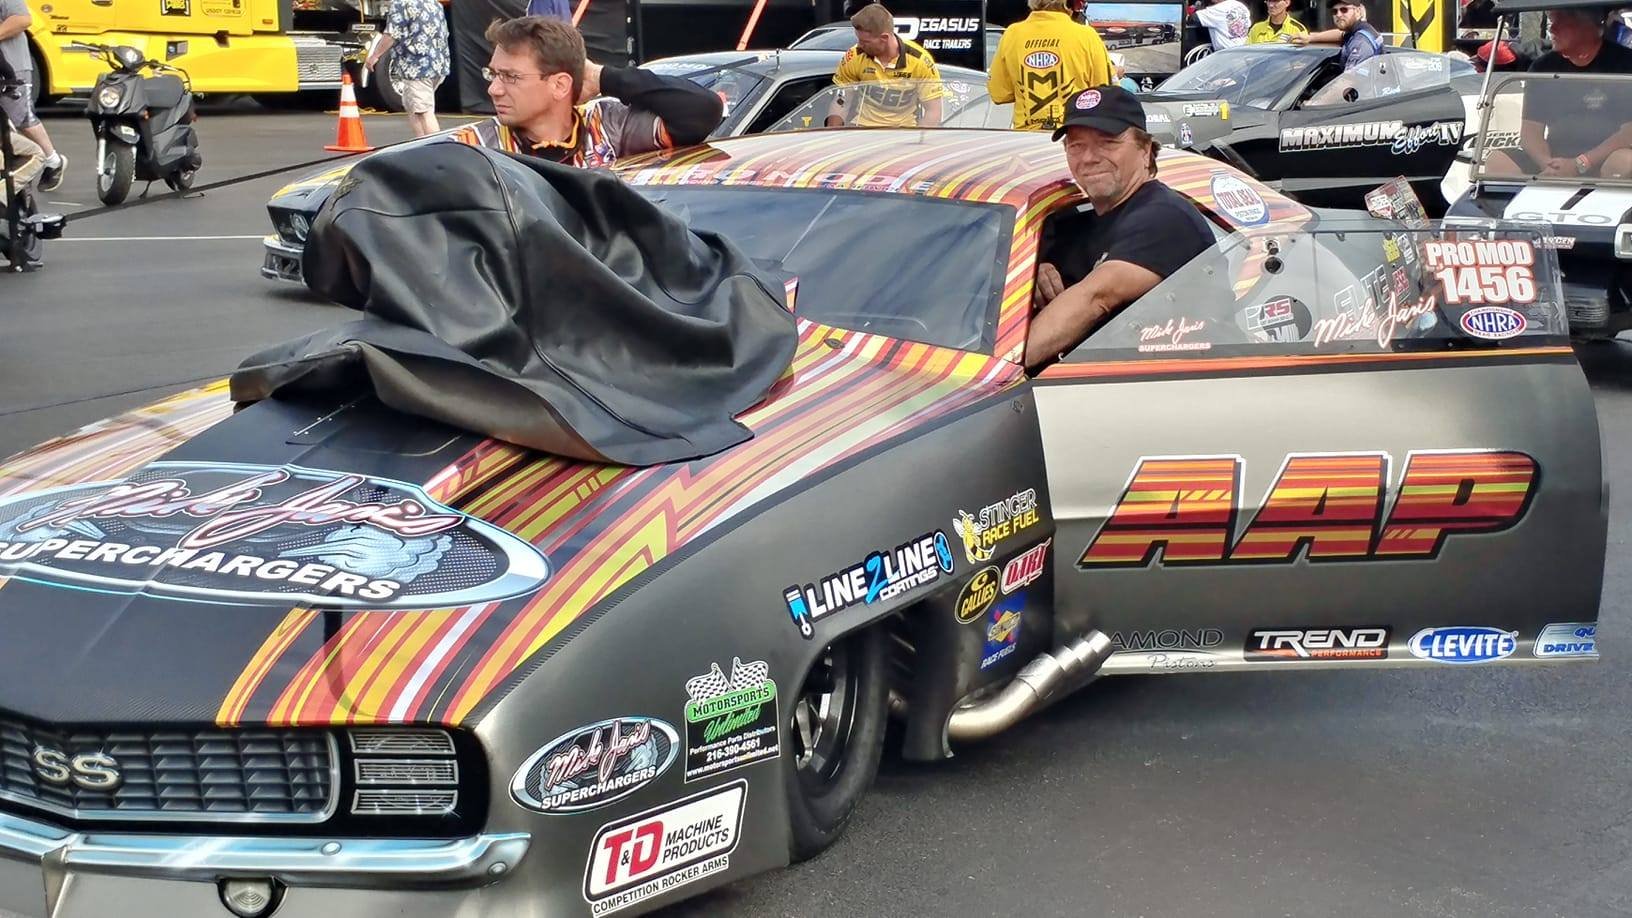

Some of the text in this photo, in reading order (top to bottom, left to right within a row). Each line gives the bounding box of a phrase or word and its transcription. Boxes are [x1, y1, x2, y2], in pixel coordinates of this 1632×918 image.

[923, 39, 972, 49] RACE TRAILERS
[1024, 38, 1061, 49] OFFICIAL
[1028, 52, 1057, 66] NHRA
[1280, 121, 1464, 155] MAXIMUM Effort IV
[1512, 211, 1612, 225] GTO
[1425, 242, 1476, 266] PRO
[1474, 241, 1533, 266] MOD
[1436, 265, 1536, 304] 1456
[1471, 312, 1517, 332] NHRA
[1138, 342, 1211, 352] SUPERCHARGERS
[979, 488, 1037, 529] STINGER
[1074, 448, 1543, 570] AAP
[982, 508, 1039, 548] RACE FUEL
[879, 567, 938, 601] COATINGS
[961, 581, 996, 618] CALLIES
[1110, 629, 1224, 650] AMOND
[1254, 628, 1387, 658] TREND
[1311, 649, 1382, 658] PERFORMANCE
[1411, 627, 1513, 660] CLEVITE
[1543, 642, 1594, 653] DRIVE
[1147, 652, 1217, 670] Pistons
[693, 686, 770, 718] MOTORSPORTS
[703, 702, 762, 743] Unlimited
[687, 743, 779, 777] www.motorsportsunlimited.net
[689, 739, 727, 756] Performance
[727, 735, 743, 746] Parts
[706, 737, 761, 763] 216-390-4561
[33, 744, 121, 790] SS
[541, 765, 657, 810] SUPERCHARGERS
[662, 828, 730, 864] PRODUCTS
[665, 814, 724, 847] MACHINE
[603, 820, 664, 886] T&D
[593, 856, 728, 914] COMPETITION ROCKER ARMS
